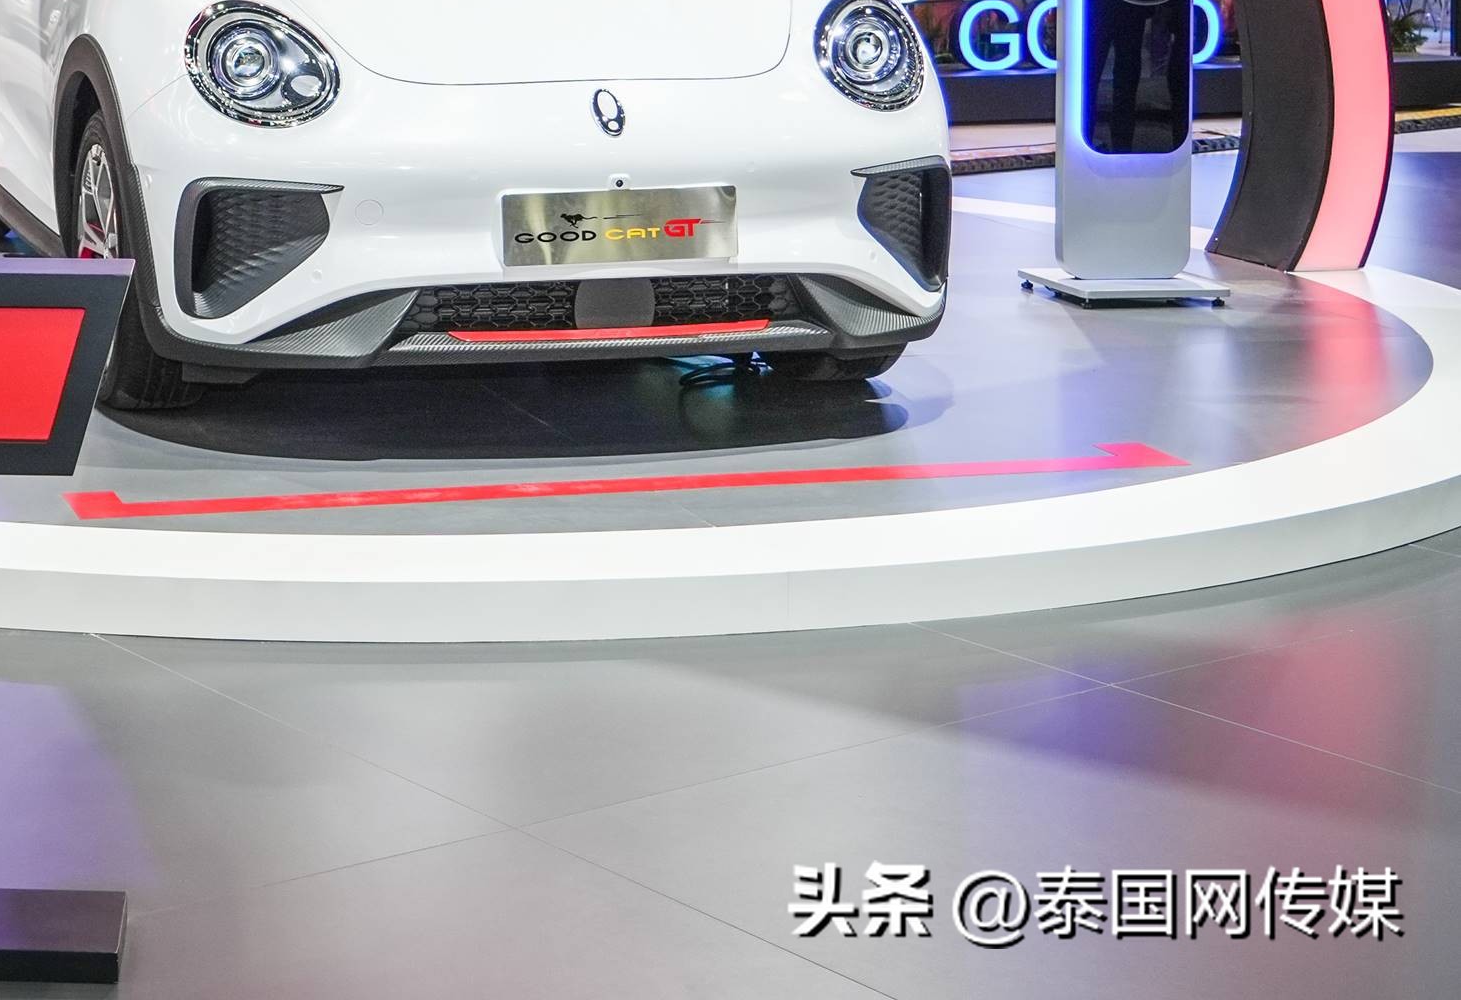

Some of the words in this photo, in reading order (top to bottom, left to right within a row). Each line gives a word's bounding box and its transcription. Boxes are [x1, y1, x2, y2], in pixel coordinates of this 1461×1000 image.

[514, 229, 597, 244] GOOD
[604, 227, 661, 241] CAT
[663, 218, 703, 238] GT
